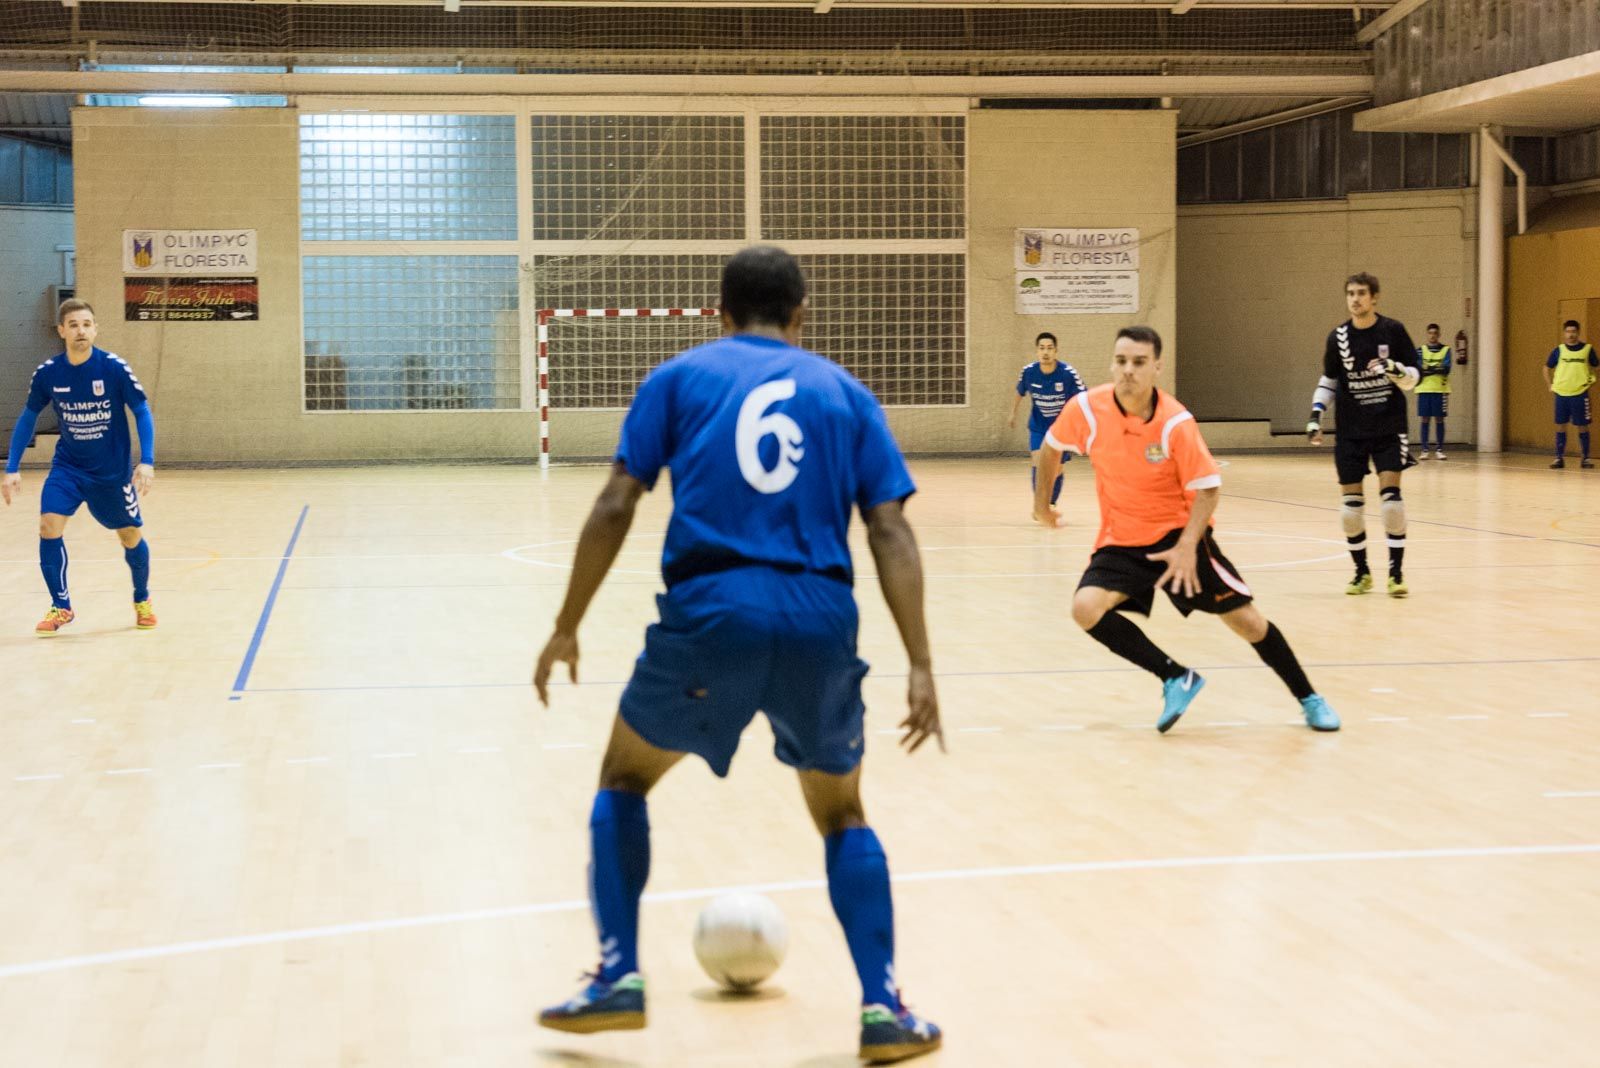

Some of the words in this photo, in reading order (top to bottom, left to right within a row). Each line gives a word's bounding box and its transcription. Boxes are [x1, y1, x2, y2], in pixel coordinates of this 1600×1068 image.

[163, 234, 249, 248] OLIMPYC
[1052, 233, 1132, 246] OLIMPYC
[164, 254, 249, 268] FLORESTA
[1053, 252, 1132, 265] FLORESTA
[735, 378, 805, 494] 6
